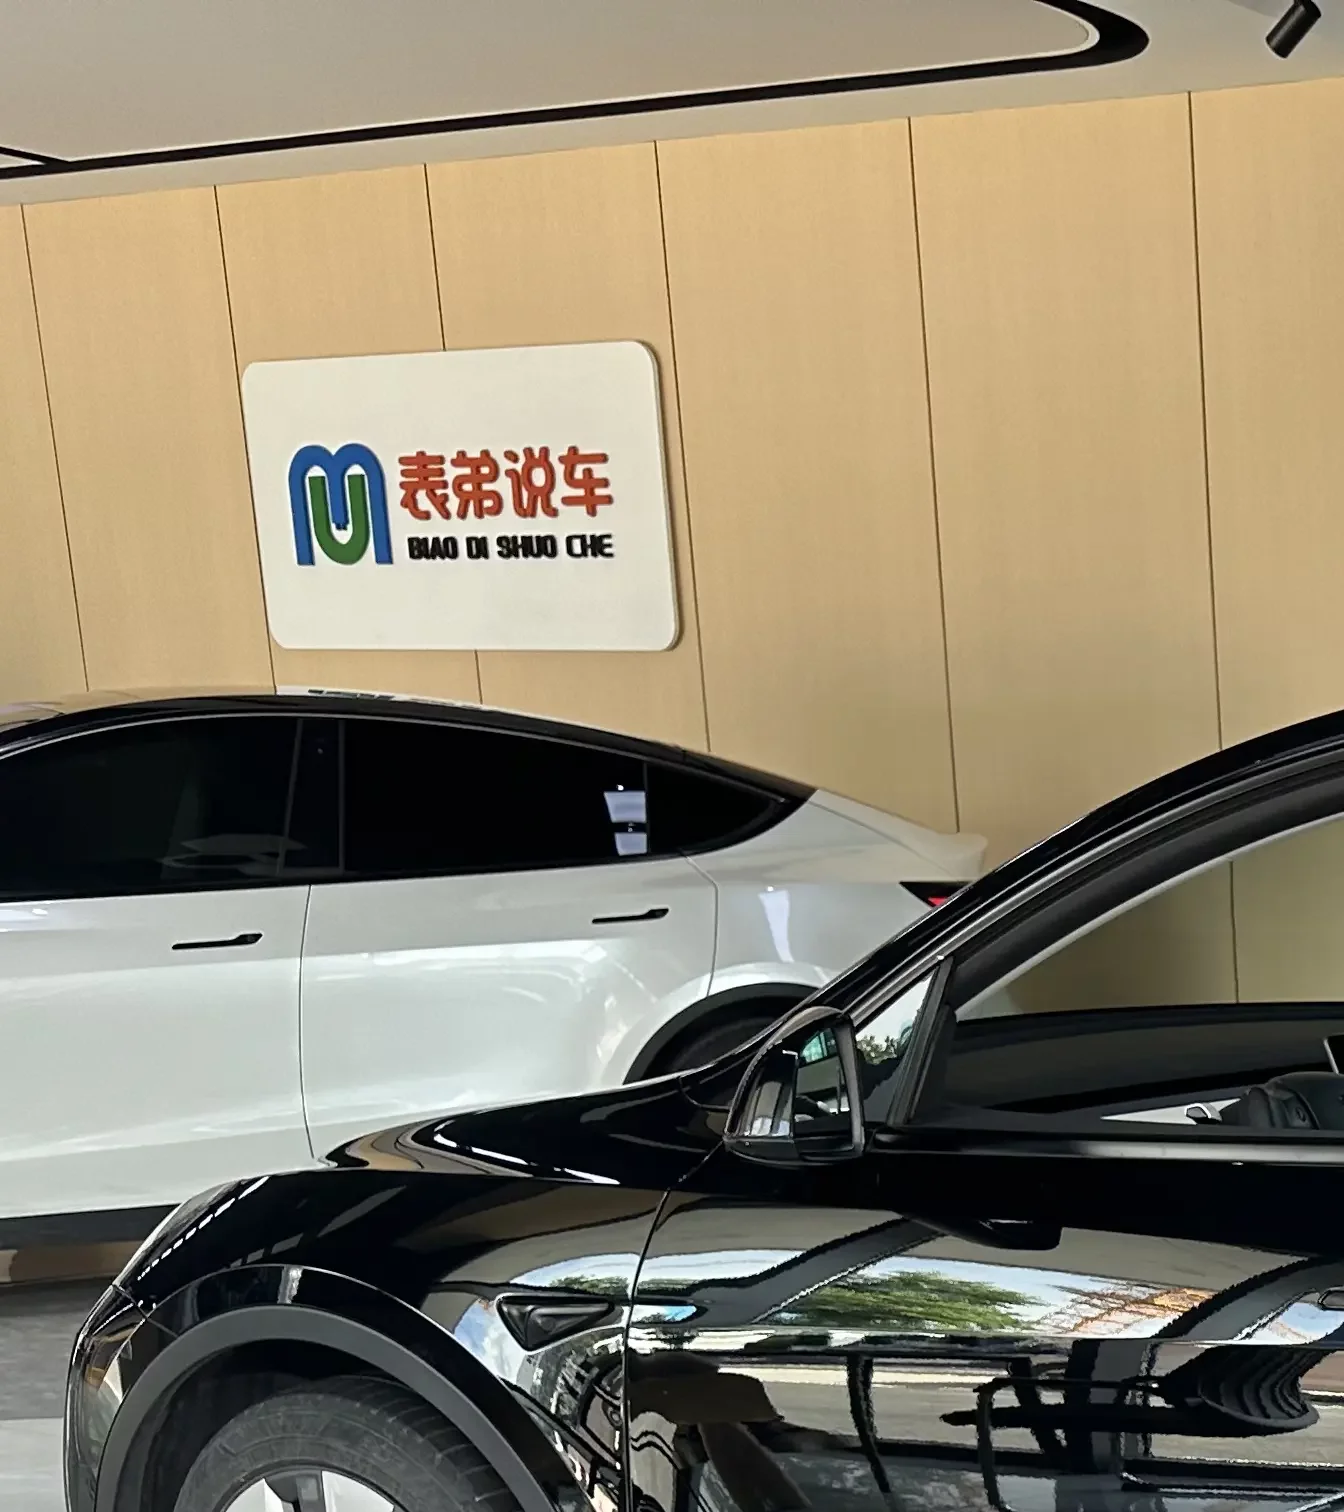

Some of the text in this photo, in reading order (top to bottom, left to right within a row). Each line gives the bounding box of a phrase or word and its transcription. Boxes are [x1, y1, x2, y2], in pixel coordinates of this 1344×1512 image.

[398, 446, 614, 521] 表弟说车
[407, 533, 615, 560] BIAO DI SHUO CHE
